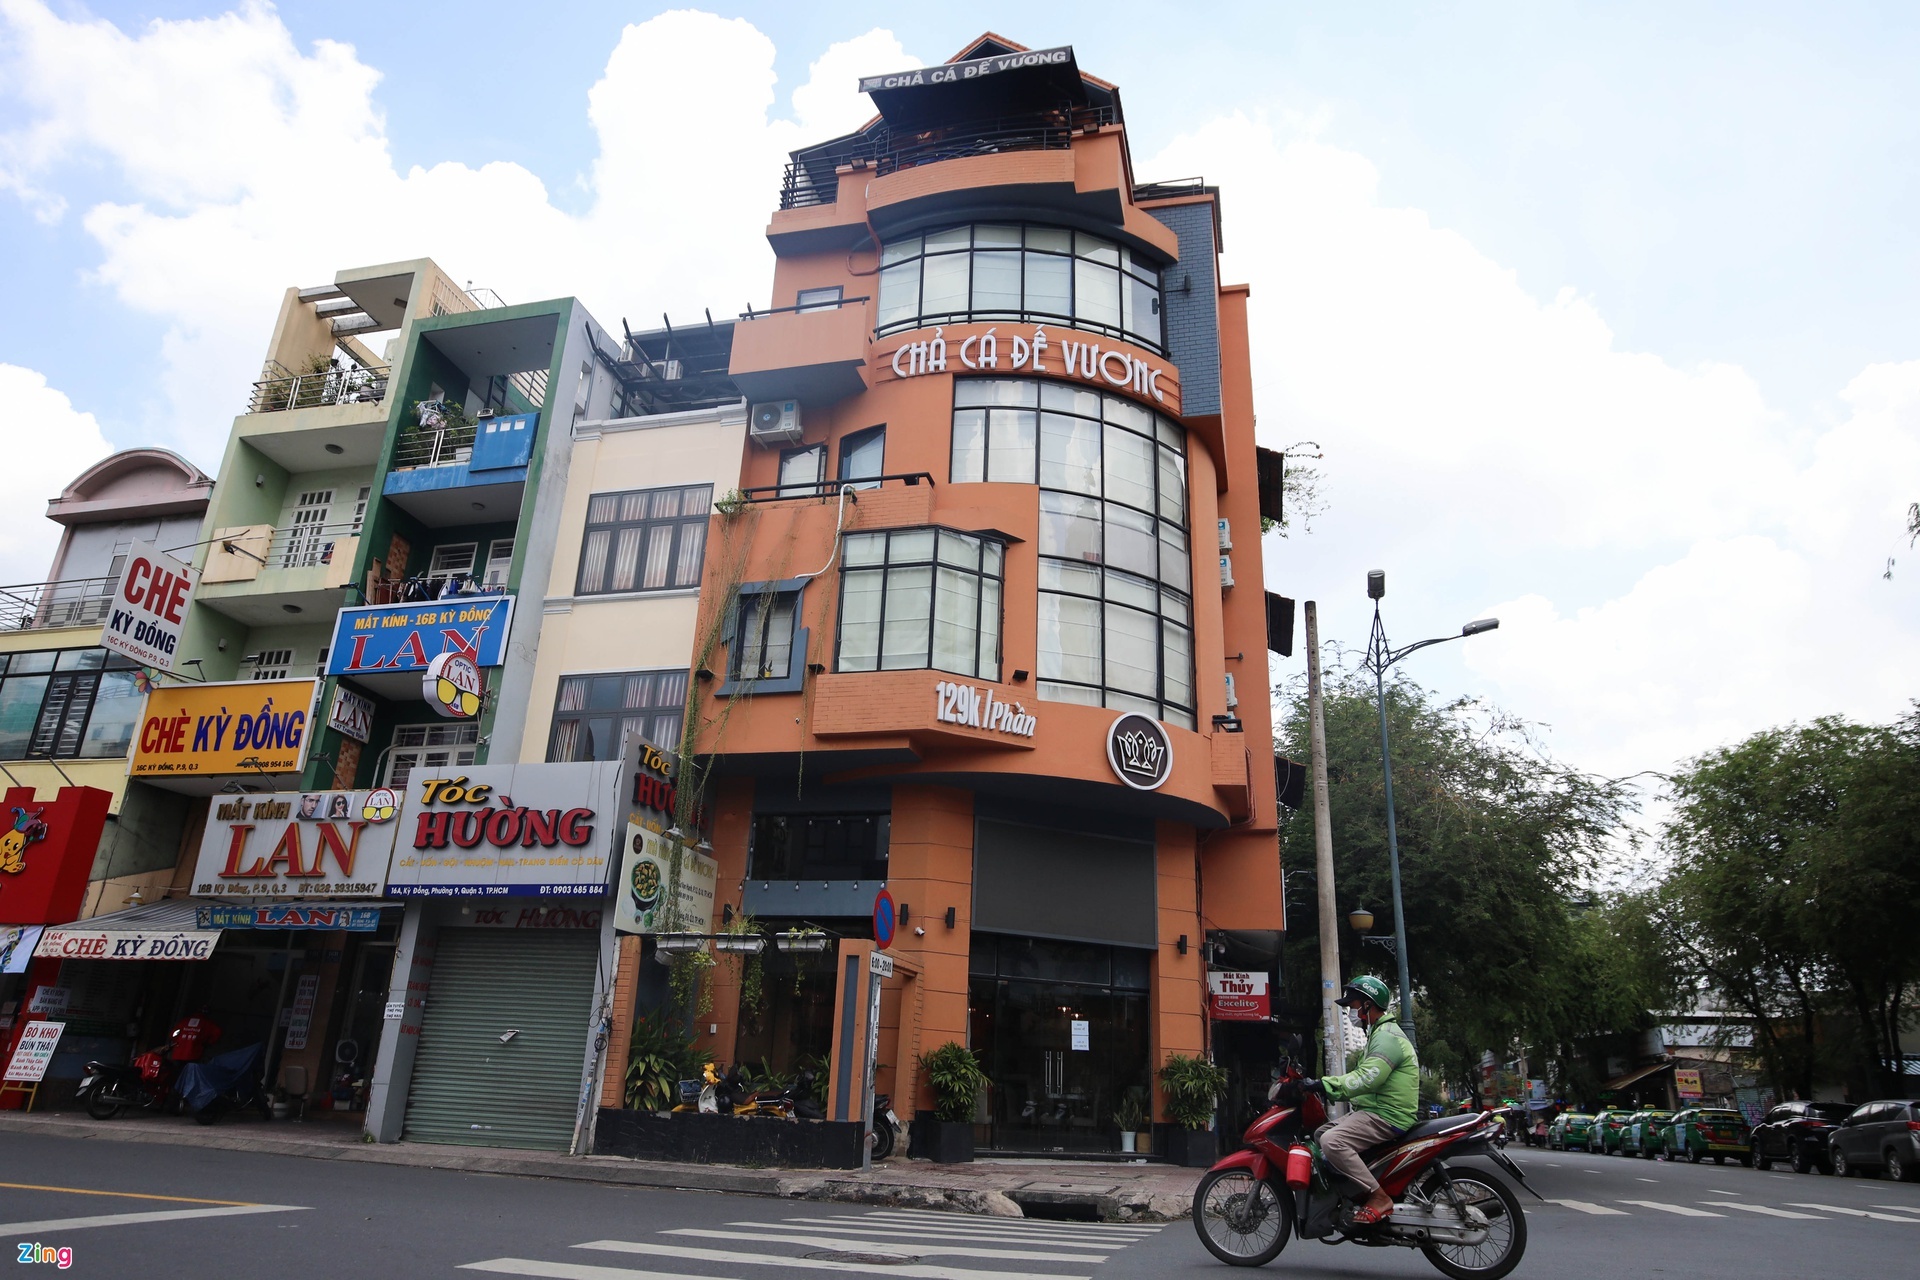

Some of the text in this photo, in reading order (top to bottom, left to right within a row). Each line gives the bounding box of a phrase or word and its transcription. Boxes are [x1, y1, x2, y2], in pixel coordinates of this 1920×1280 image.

[884, 50, 1067, 88] CHẢ CÁ ĐẾ VƯƠNG
[892, 324, 1163, 403] CHẢ CÁ ĐẾ VƯƠNG
[124, 557, 191, 625] CHÈ
[354, 613, 379, 630] MẮT
[381, 613, 408, 628] KÍNH
[415, 613, 436, 626] 16B
[439, 609, 456, 624] KỲ
[459, 605, 491, 622] ĐỒNG
[107, 635, 118, 646] 16C
[110, 609, 176, 655] KỲ ĐỒNG
[343, 626, 489, 671] LAN
[446, 665, 475, 691] LAN
[455, 660, 471, 673] OPTIC
[141, 697, 305, 753] CHÈ KỲ ĐỒNG
[332, 700, 373, 735] LAN
[136, 764, 147, 772] 16C
[282, 760, 294, 768] 166
[216, 797, 291, 821] MẮT KÍNH
[369, 797, 391, 806] LAN
[413, 795, 595, 849] HƯỜNG
[218, 821, 369, 878] LAN
[519, 858, 547, 866] TRANG
[431, 887, 453, 896] Phường
[461, 887, 477, 896] Quận
[553, 885, 572, 894] 0903
[573, 885, 588, 894] 685
[589, 885, 603, 894] 884
[213, 909, 338, 926] MẮT KÍNH LAN
[63, 933, 210, 957] CHÈ KỲ ĐỒNG
[1362, 982, 1379, 996] Grab
[25, 1024, 38, 1038] BÒ
[39, 1027, 58, 1039] KHO
[19, 1038, 54, 1052] BÚN THÁI
